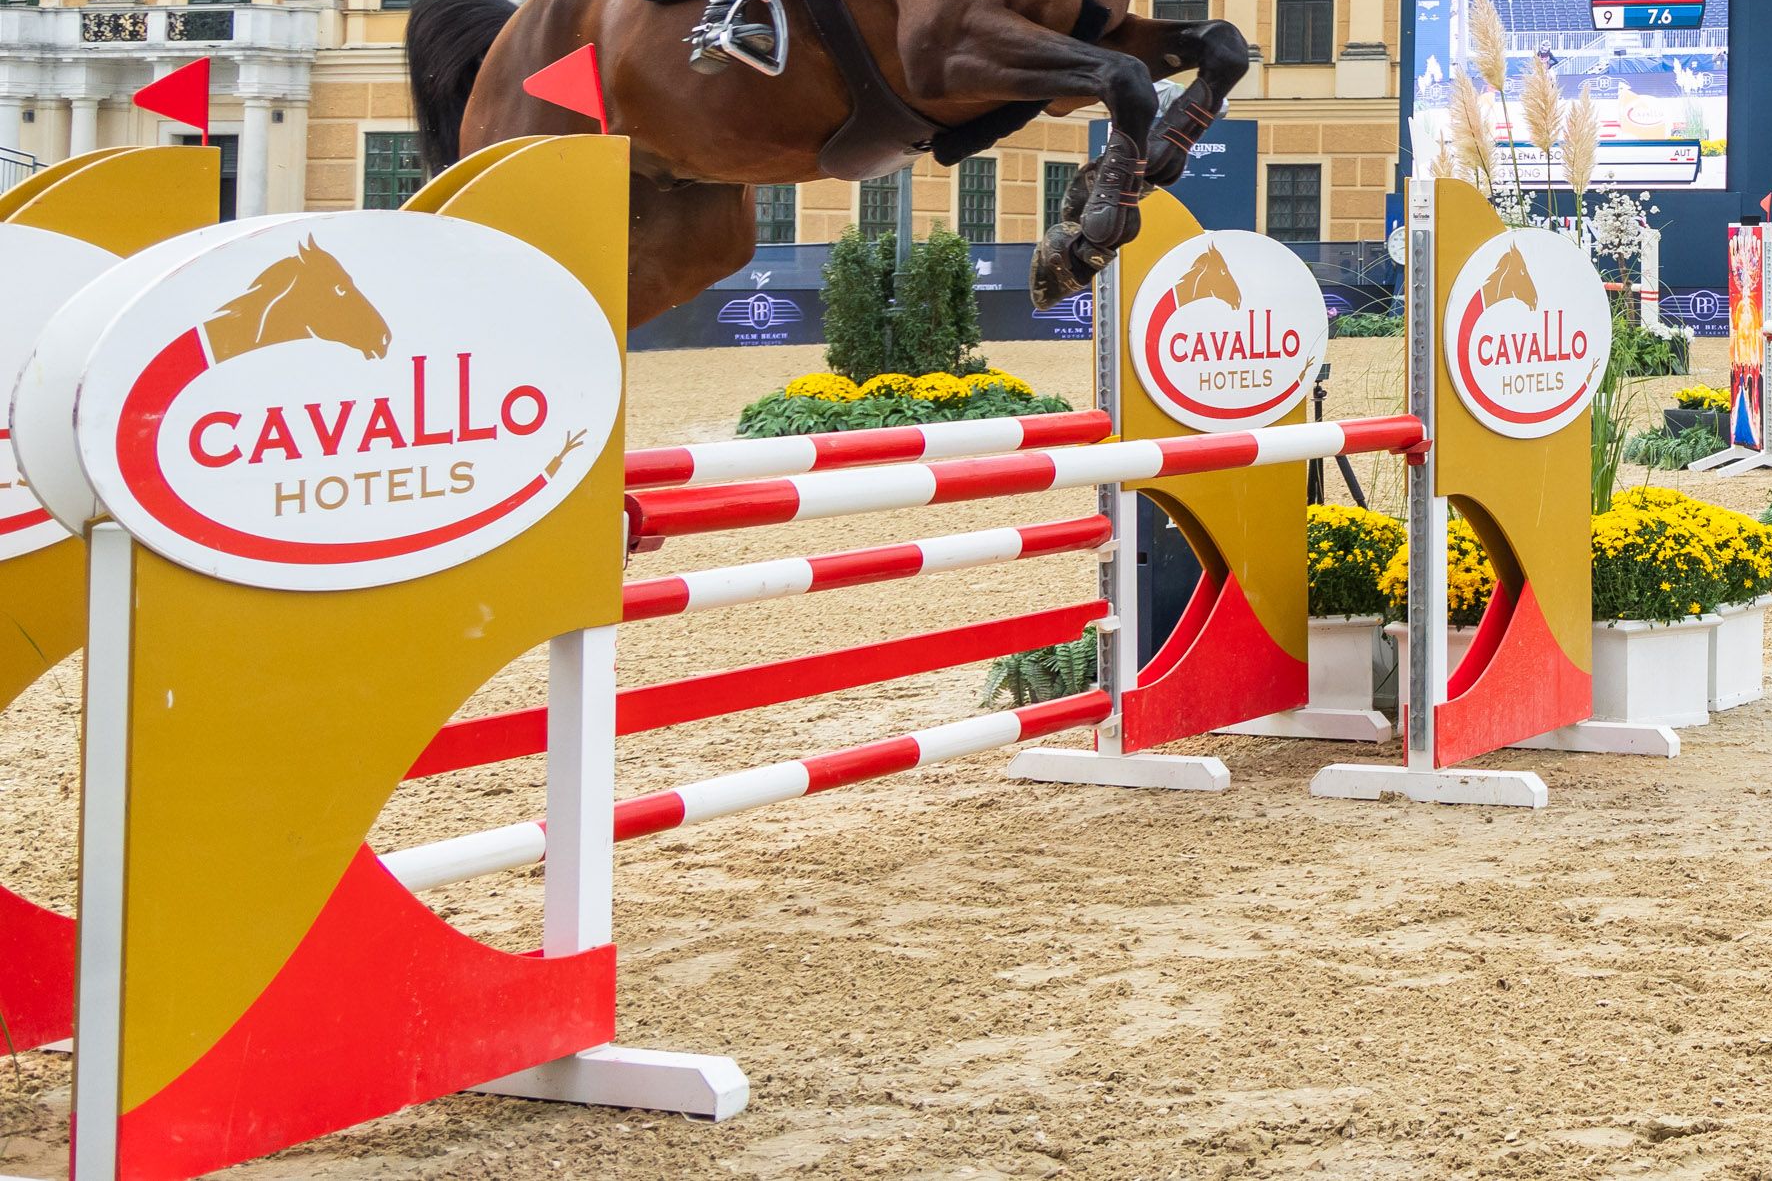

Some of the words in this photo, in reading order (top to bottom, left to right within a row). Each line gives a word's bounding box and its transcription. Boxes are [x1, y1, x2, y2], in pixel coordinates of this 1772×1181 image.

[1604, 10, 1612, 24] 9
[1648, 9, 1672, 24] 7.6
[1673, 149, 1690, 157] AUT
[1200, 369, 1273, 391] HOTELS
[1502, 371, 1565, 396] HOTELS
[274, 461, 475, 517] HOTELS
